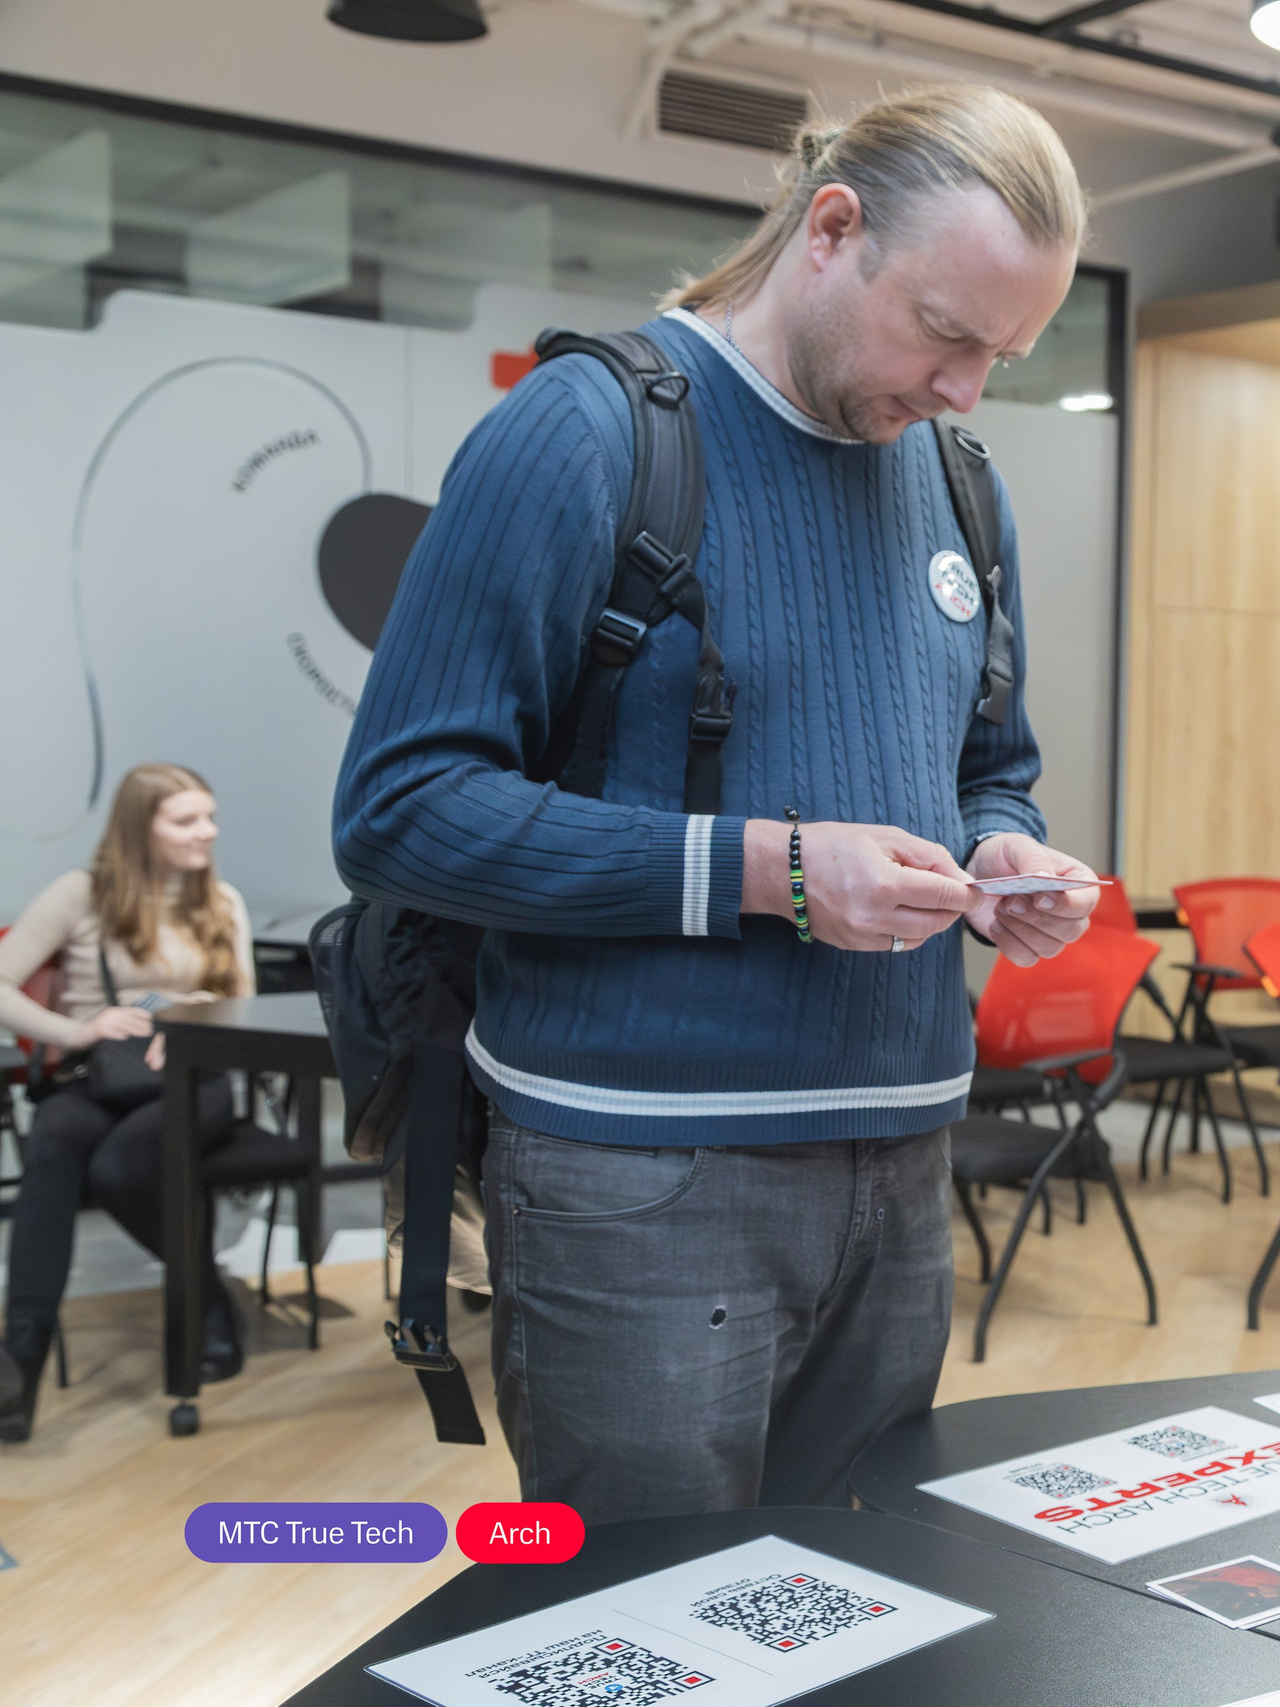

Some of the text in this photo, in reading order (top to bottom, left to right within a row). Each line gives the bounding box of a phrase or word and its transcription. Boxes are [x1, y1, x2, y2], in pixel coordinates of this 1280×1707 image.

[232, 429, 319, 493] КОМАНДА
[1153, 1475, 1250, 1504] TECH
[1056, 1499, 1155, 1534] ARCH
[688, 1573, 782, 1607] Оставь свой
[704, 1578, 751, 1596] отзыв
[464, 1629, 603, 1678] на наш ТГ-канал
[477, 1634, 608, 1679] Подписывайся
